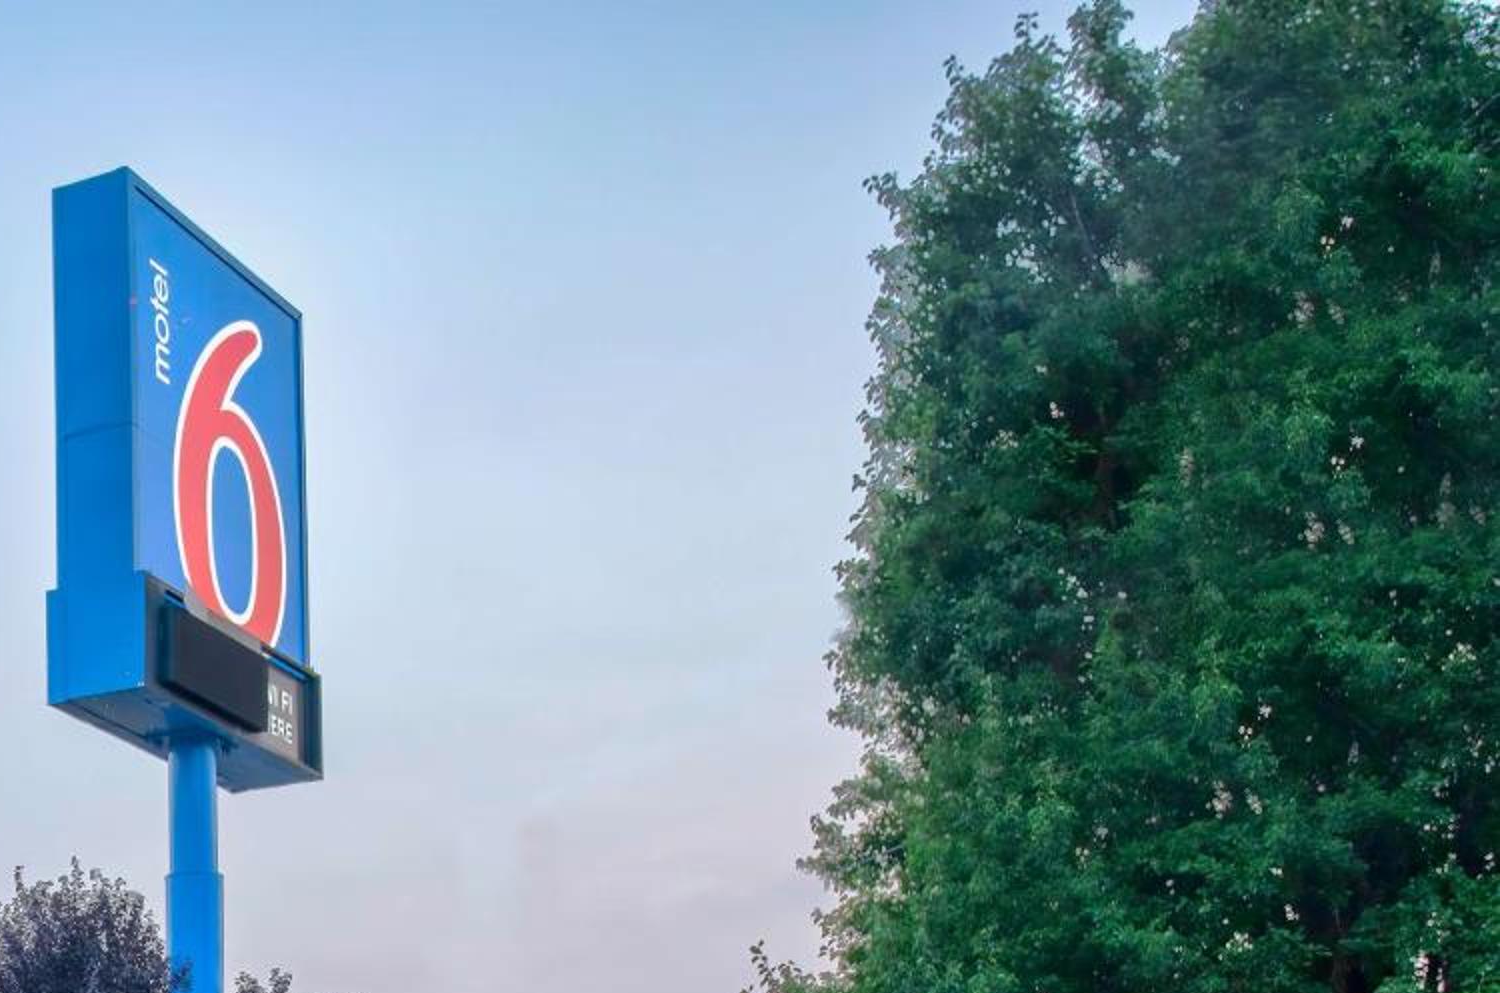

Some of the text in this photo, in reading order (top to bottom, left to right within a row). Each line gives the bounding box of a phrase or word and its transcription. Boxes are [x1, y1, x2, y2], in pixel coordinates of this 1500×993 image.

[149, 257, 171, 385] motel
[173, 319, 287, 651] 6
[268, 714, 293, 745] ERE
